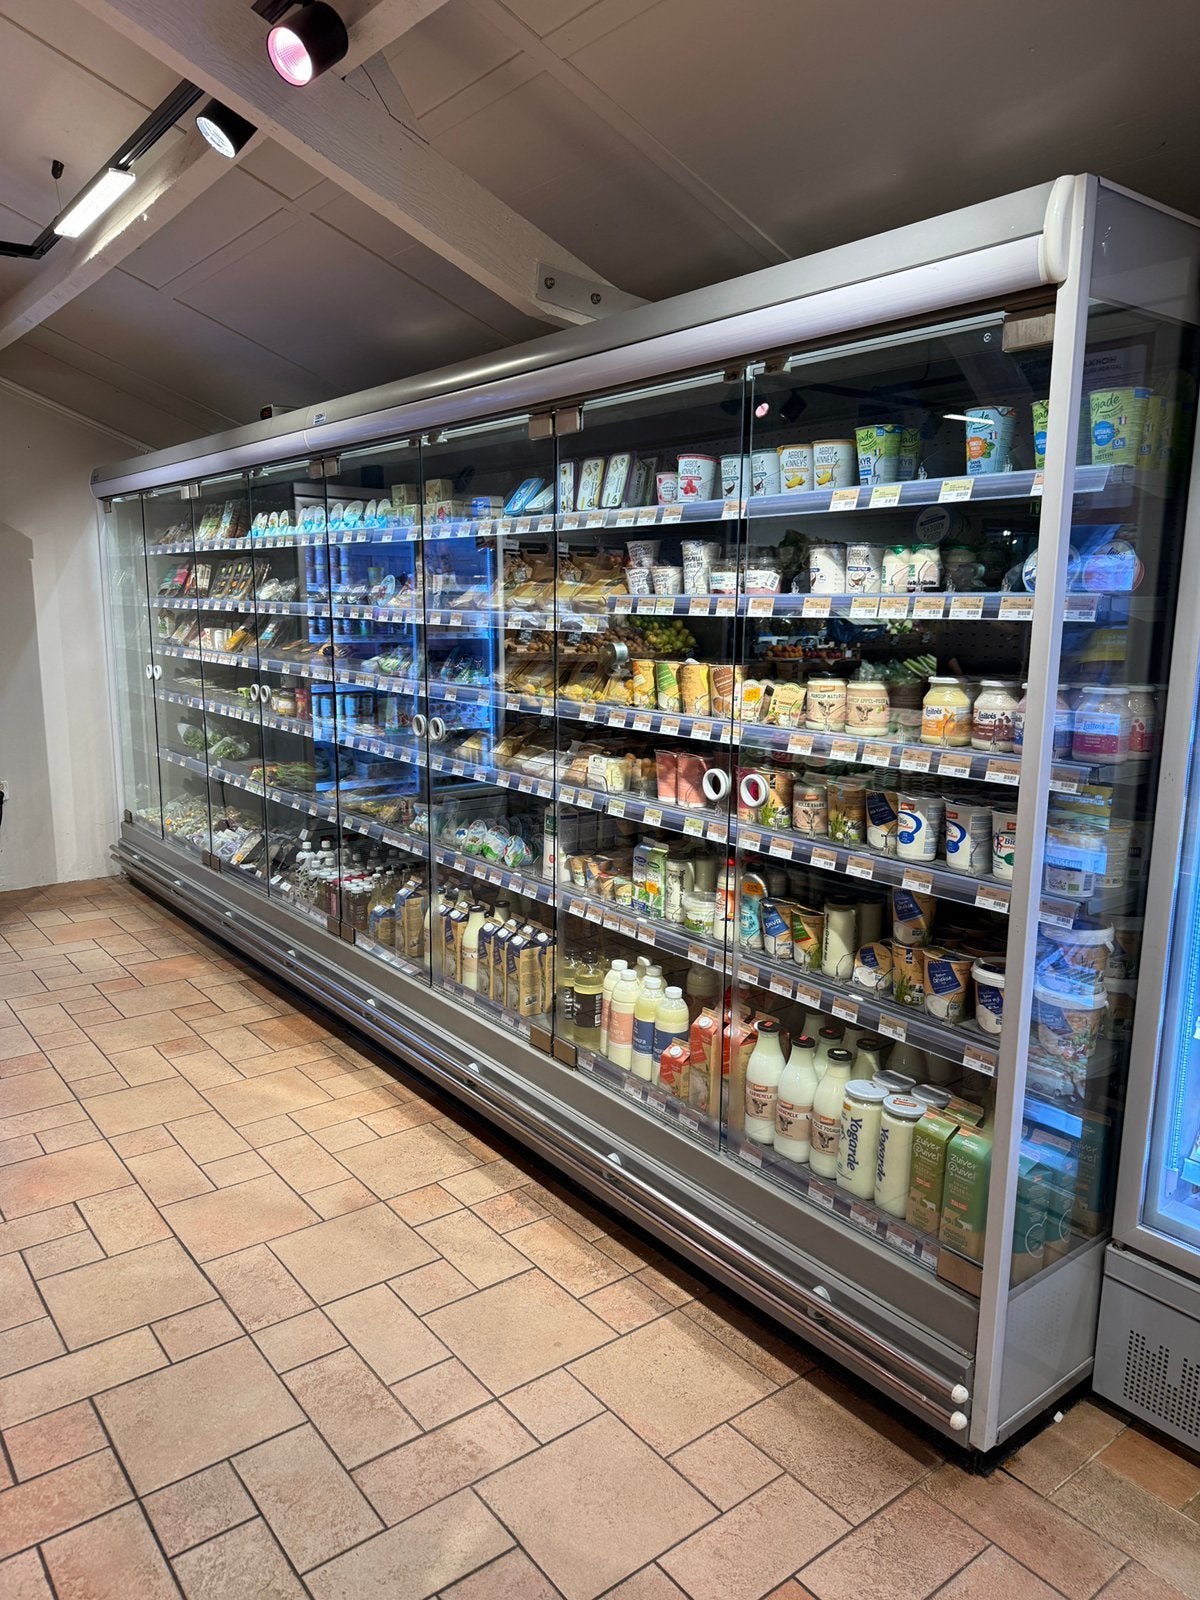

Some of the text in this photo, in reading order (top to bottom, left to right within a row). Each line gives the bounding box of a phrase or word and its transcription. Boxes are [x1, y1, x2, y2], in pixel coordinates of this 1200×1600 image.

[787, 450, 804, 459] ABBOT
[819, 447, 835, 456] ABBOT
[846, 1116, 863, 1171] Yogarde
[915, 1135, 941, 1152] Zuiver
[876, 1127, 889, 1182] Yogarde
[950, 1153, 977, 1169] Zuiver
